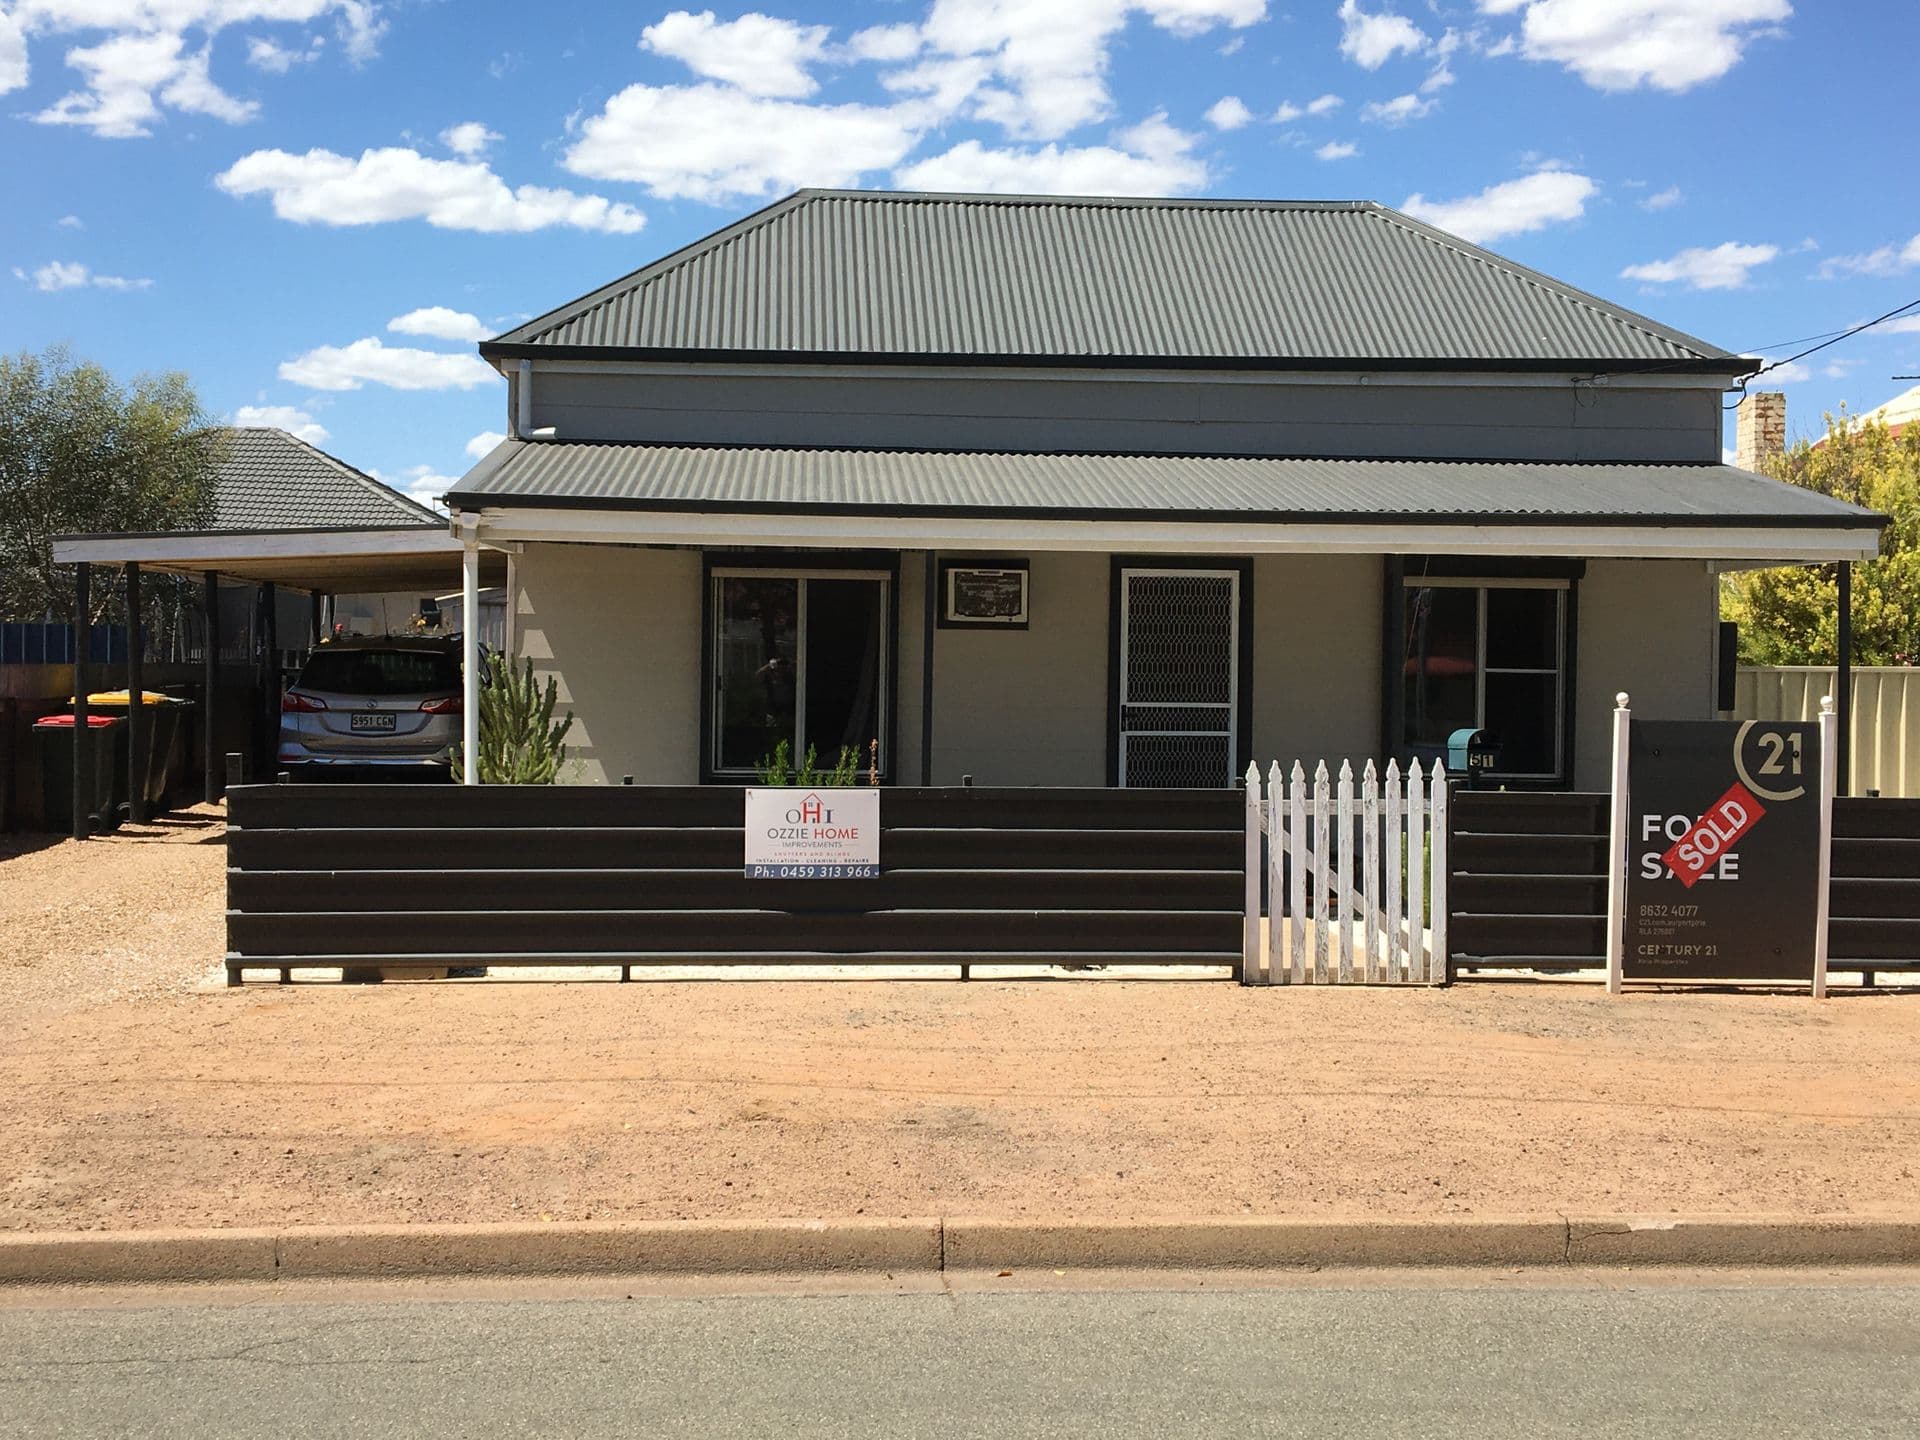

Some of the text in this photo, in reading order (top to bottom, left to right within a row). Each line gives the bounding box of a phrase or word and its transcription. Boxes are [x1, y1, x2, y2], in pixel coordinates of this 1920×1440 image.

[353, 716, 373, 725] S951
[1471, 755, 1491, 767] 51
[767, 828, 859, 839] OZZIE HOME
[1642, 814, 1705, 842] FO
[1678, 800, 1748, 870] SOLD
[754, 866, 871, 878] Ph: 0459 313 966
[1640, 905, 1698, 917] 8632 4077
